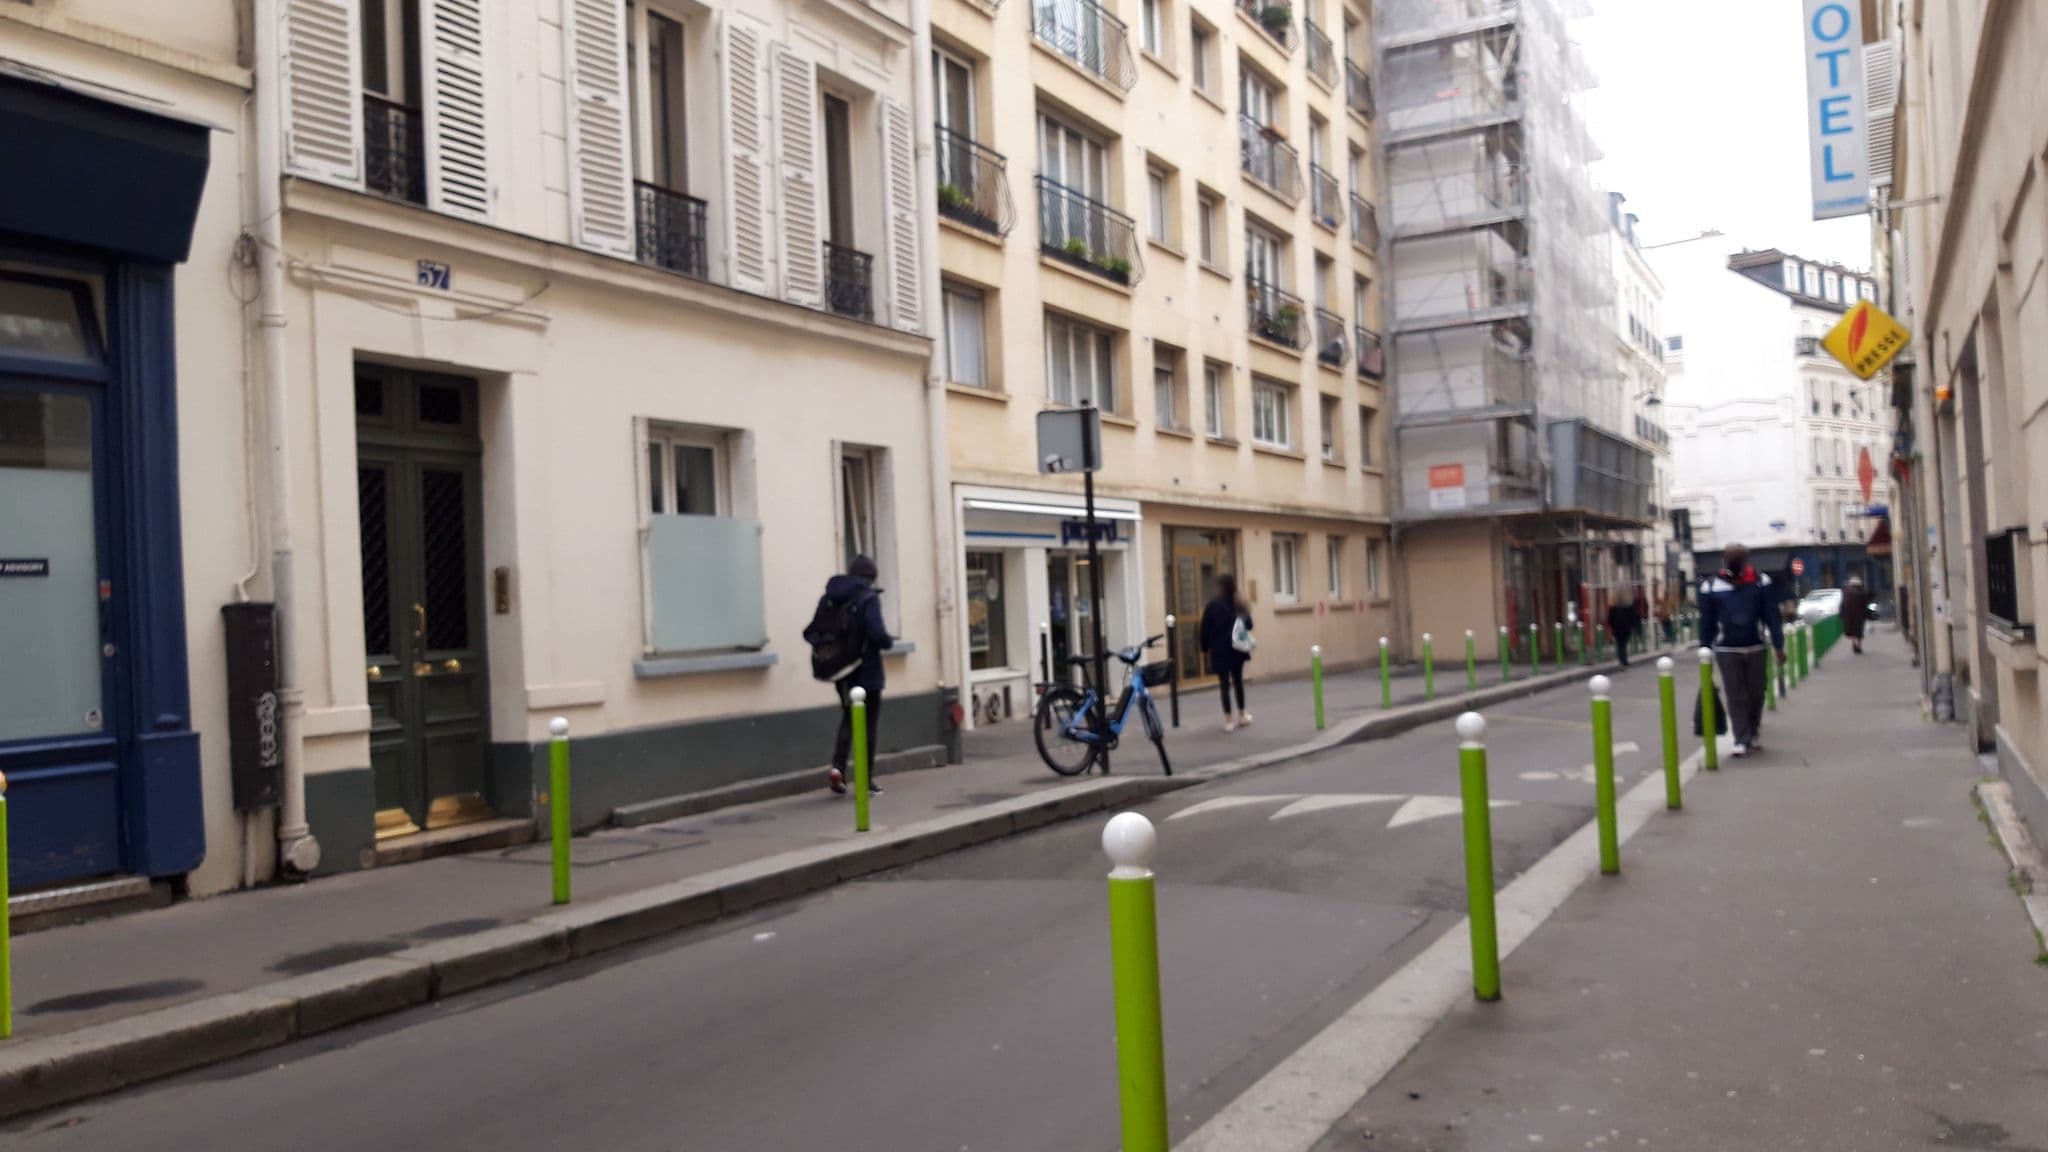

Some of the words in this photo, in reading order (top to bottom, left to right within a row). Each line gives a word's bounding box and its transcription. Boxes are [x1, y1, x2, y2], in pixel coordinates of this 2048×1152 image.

[1811, 3, 1856, 183] OTEL
[418, 261, 448, 288] 57
[1856, 328, 1902, 374] PRESSE
